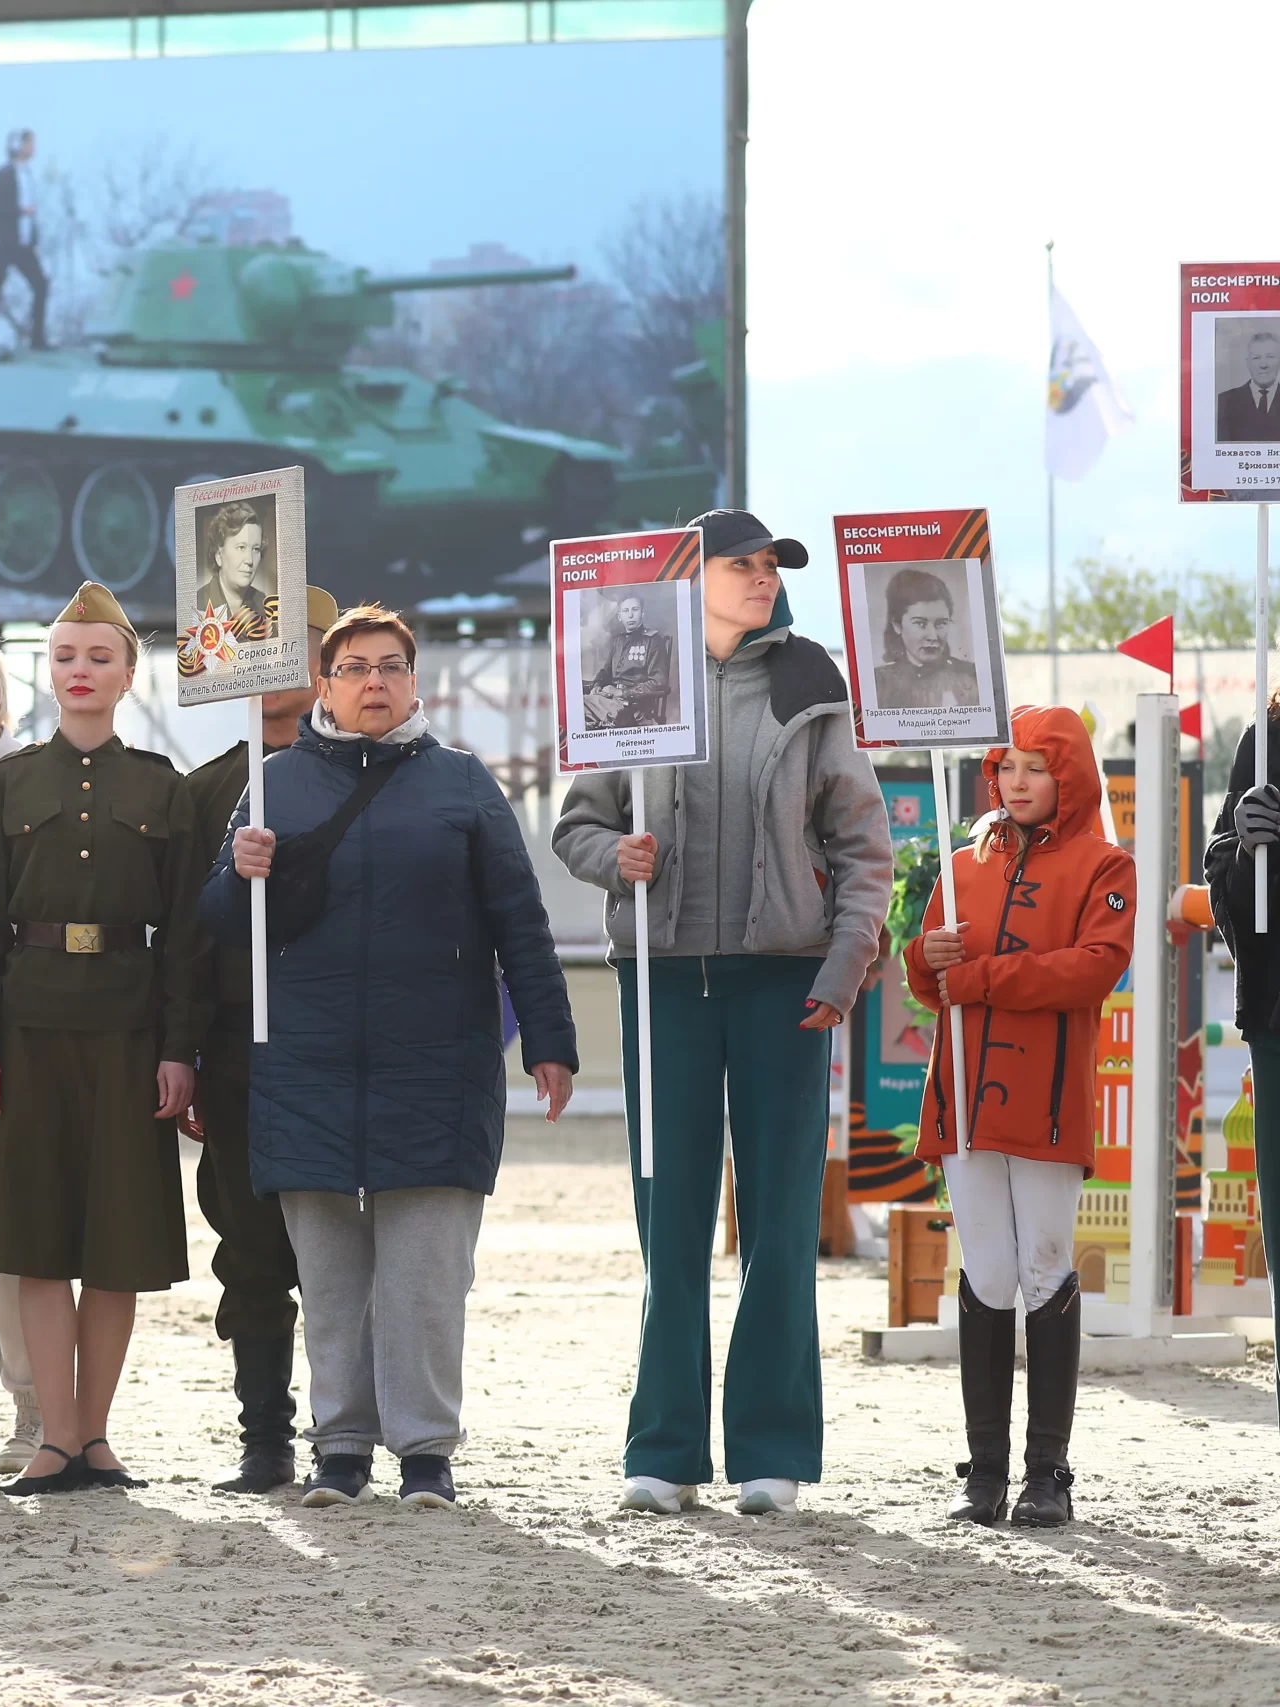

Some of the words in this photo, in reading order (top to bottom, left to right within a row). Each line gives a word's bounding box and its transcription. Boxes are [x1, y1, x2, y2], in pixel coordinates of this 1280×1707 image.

[1191, 292, 1230, 304] ПОЛК
[1215, 449, 1261, 457] Шехватов
[1267, 449, 1280, 457] Ни
[189, 481, 257, 503] Бессмертный
[260, 478, 282, 490] полк
[843, 522, 941, 539] БЕССМЕРТНЫЙ
[562, 545, 655, 566] БЕССМЕРТНЫЙ
[845, 543, 882, 555] ПОЛК
[562, 568, 597, 582] ПОЛК
[237, 647, 278, 661] Серкова
[280, 641, 299, 654] Л.Г.
[233, 663, 272, 676] Труженик
[273, 658, 299, 669] тыла
[180, 686, 210, 698] Житель
[211, 679, 254, 692] блокадного
[255, 670, 299, 686] Ленинграда
[865, 709, 900, 718] Тарасова
[901, 707, 947, 717] Александра
[948, 705, 992, 715] Андреевна
[898, 719, 936, 728] Младший
[937, 718, 971, 728] Сержант
[571, 731, 608, 740] Сихвонин
[608, 727, 642, 737] Николай
[643, 724, 690, 734] Николаевич
[615, 739, 655, 748] Лейтенант
